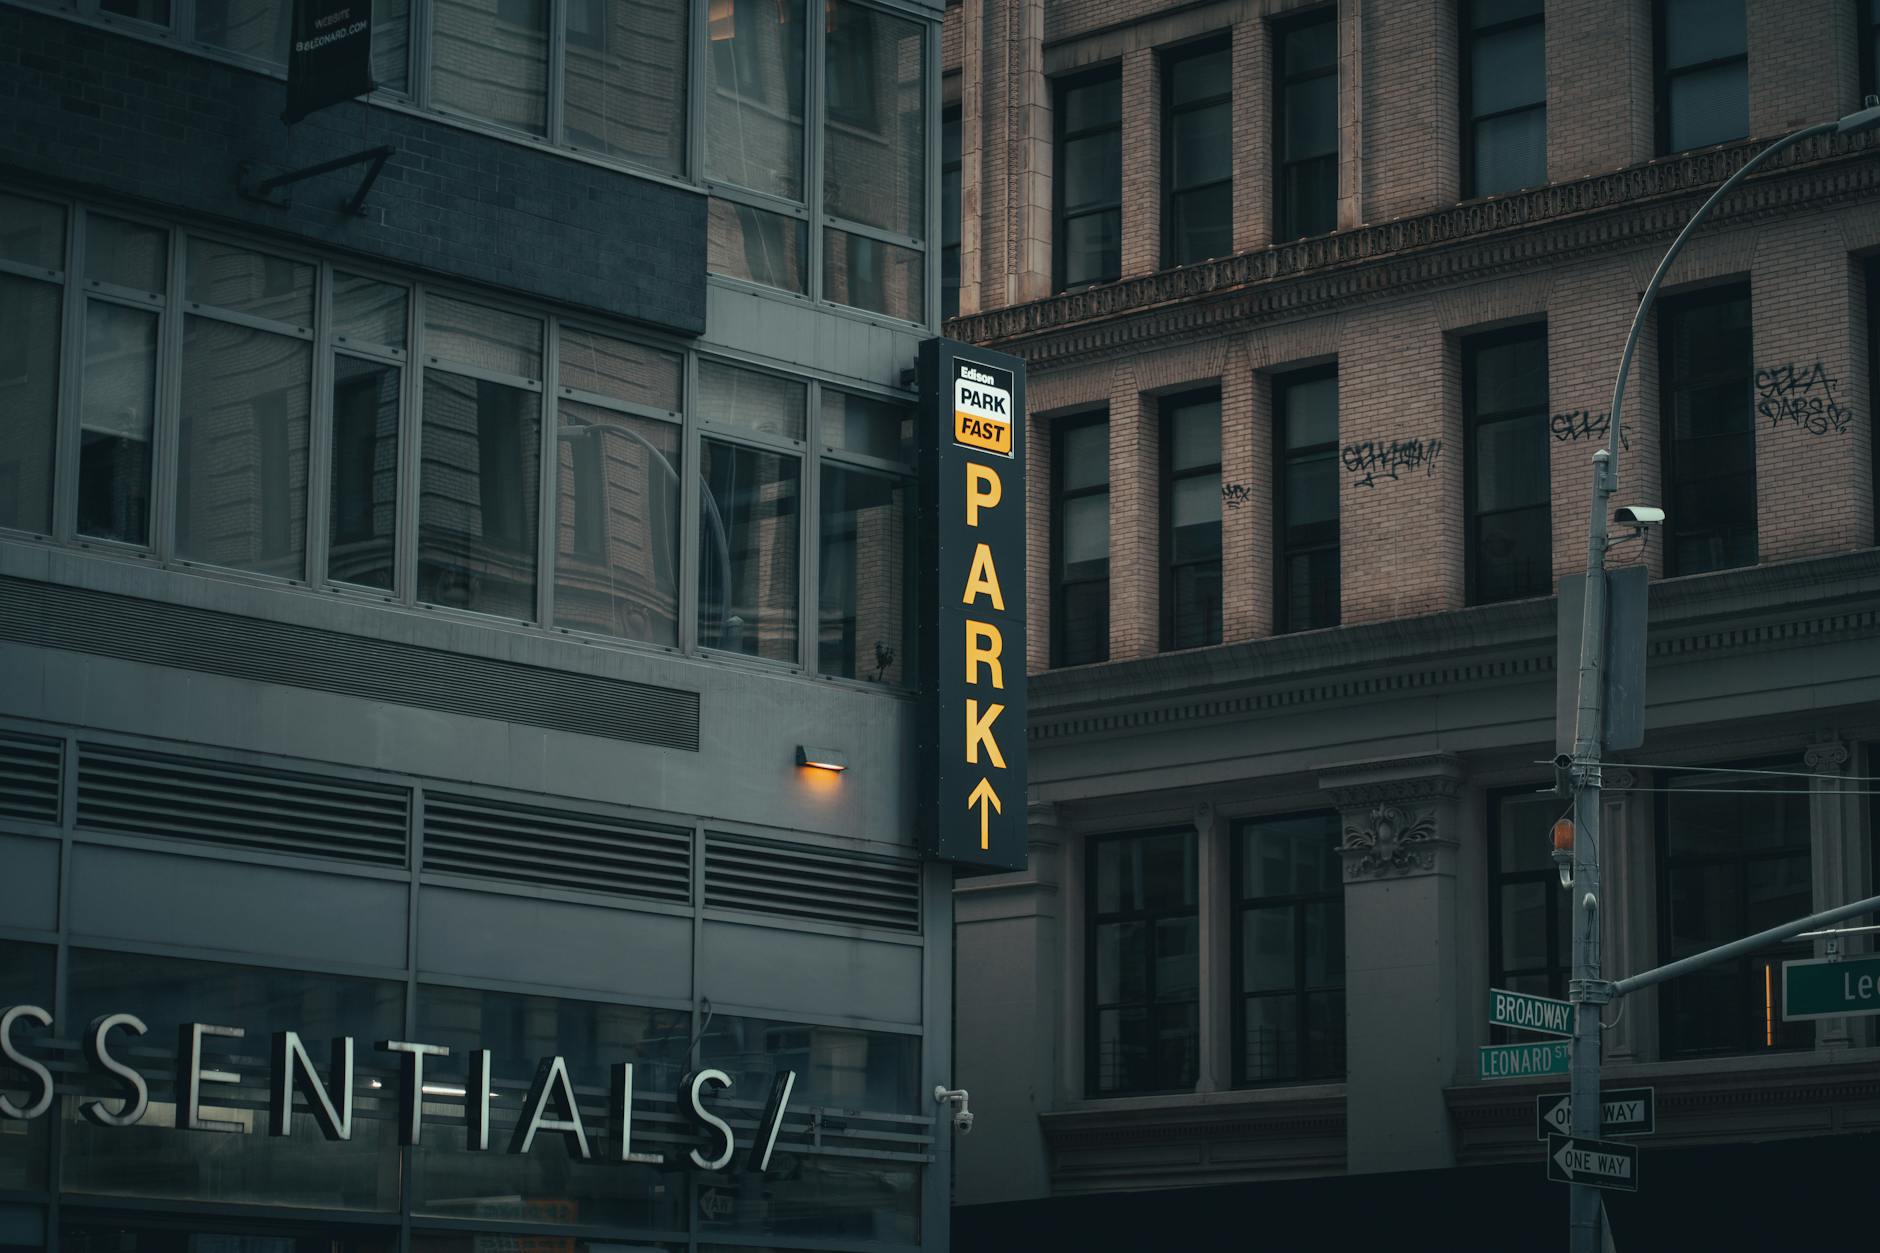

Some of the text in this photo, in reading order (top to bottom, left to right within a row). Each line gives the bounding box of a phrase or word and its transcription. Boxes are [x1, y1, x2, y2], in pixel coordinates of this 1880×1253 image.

[960, 366, 995, 385] Edison
[961, 387, 1006, 415] PARK
[961, 417, 1005, 443] FAST
[962, 461, 1007, 769] PARK
[1844, 971, 1880, 1001] Le
[1496, 994, 1570, 1031] BROADWAY
[1481, 1045, 1569, 1076] LEONARD ST
[1602, 1103, 1637, 1121] WAY
[1565, 1151, 1625, 1175] ONE WAY
